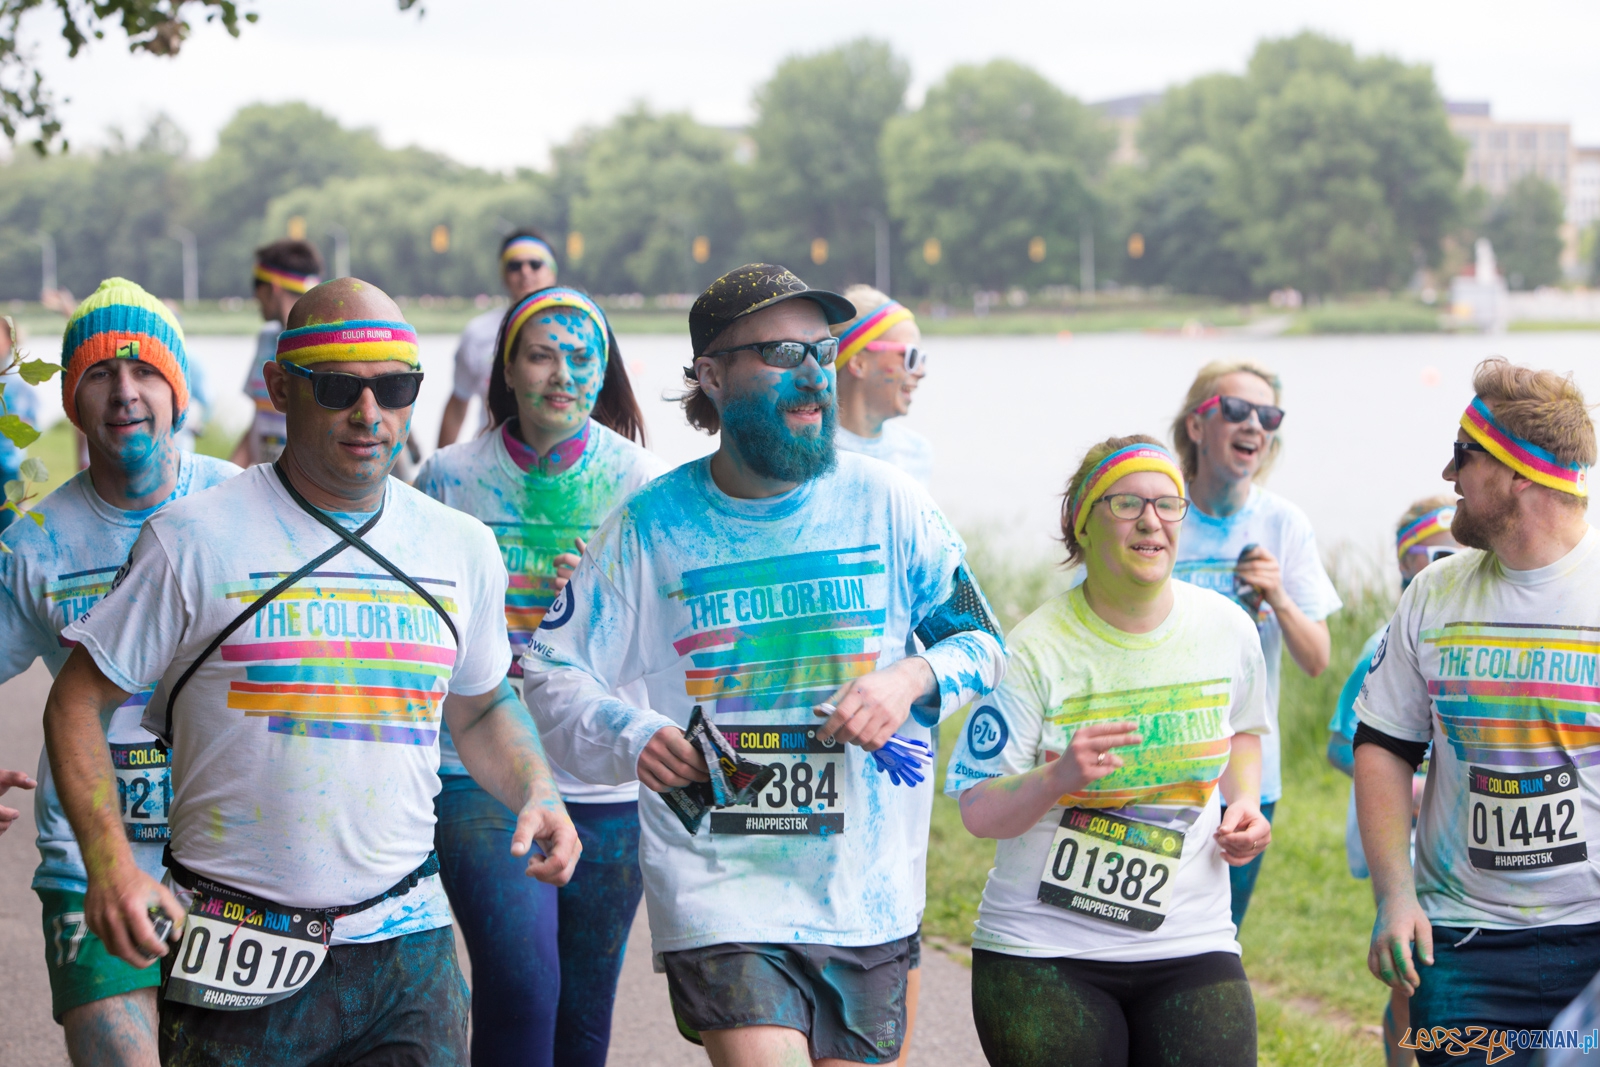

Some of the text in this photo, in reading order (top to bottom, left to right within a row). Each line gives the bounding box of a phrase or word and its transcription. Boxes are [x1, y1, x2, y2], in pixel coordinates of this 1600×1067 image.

[342, 330, 392, 340] COLOR RUNNER
[686, 592, 731, 630] THE
[733, 582, 820, 622] COLOR
[254, 602, 301, 638] THE
[306, 601, 393, 640] COLOR
[1438, 647, 1474, 677] THE
[1475, 648, 1546, 680] COLOR
[741, 732, 779, 748] COLOR
[974, 720, 997, 746] PZU
[1475, 774, 1488, 791] THE
[1488, 777, 1519, 795] COLOR
[746, 817, 808, 830] #HAPPIEST5K
[1069, 810, 1092, 829] THE
[1089, 817, 1127, 840] COLOR
[1473, 799, 1578, 847] 01442
[1052, 837, 1170, 908] 01382
[1495, 852, 1554, 867] #HAPPIEST5K
[1071, 895, 1132, 922] #HAPPIEST5K
[181, 926, 316, 990] 01910
[203, 989, 267, 1007] #HAPPIEST5K
[876, 1039, 896, 1048] RUN
